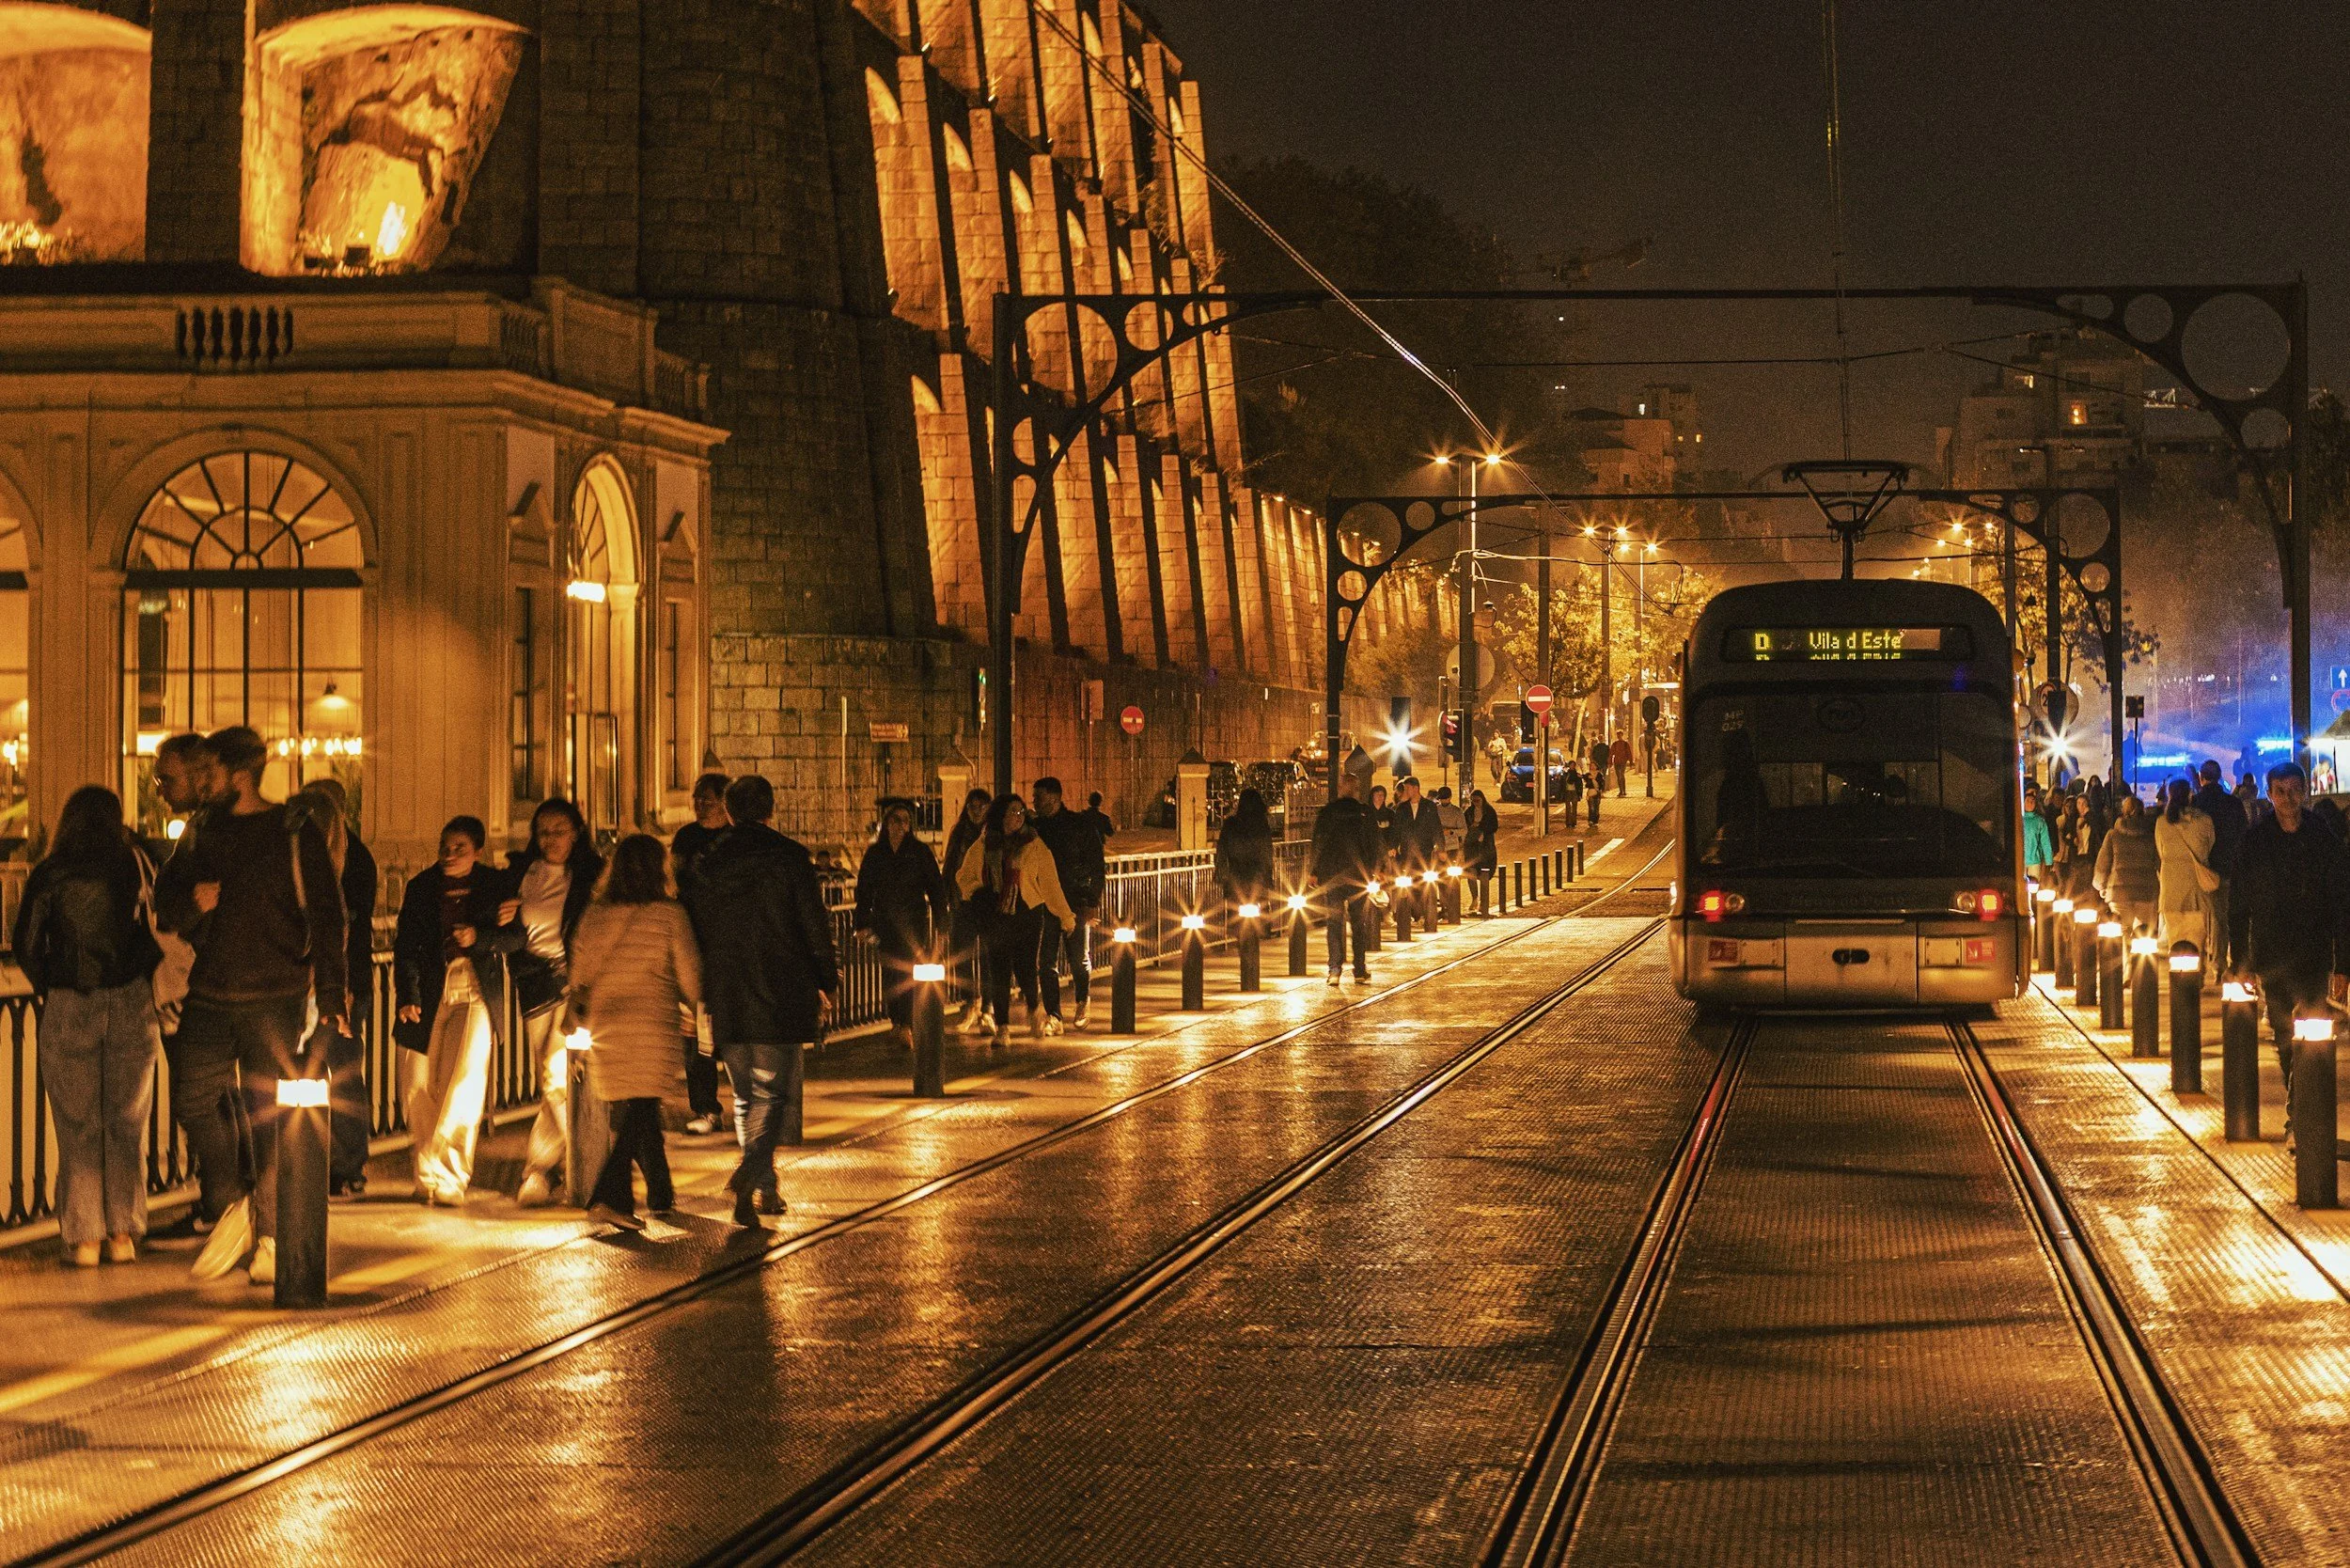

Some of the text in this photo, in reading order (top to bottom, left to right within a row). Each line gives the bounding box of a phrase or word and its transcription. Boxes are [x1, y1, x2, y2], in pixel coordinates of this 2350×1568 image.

[1755, 632, 1902, 650] D Vila d Este
